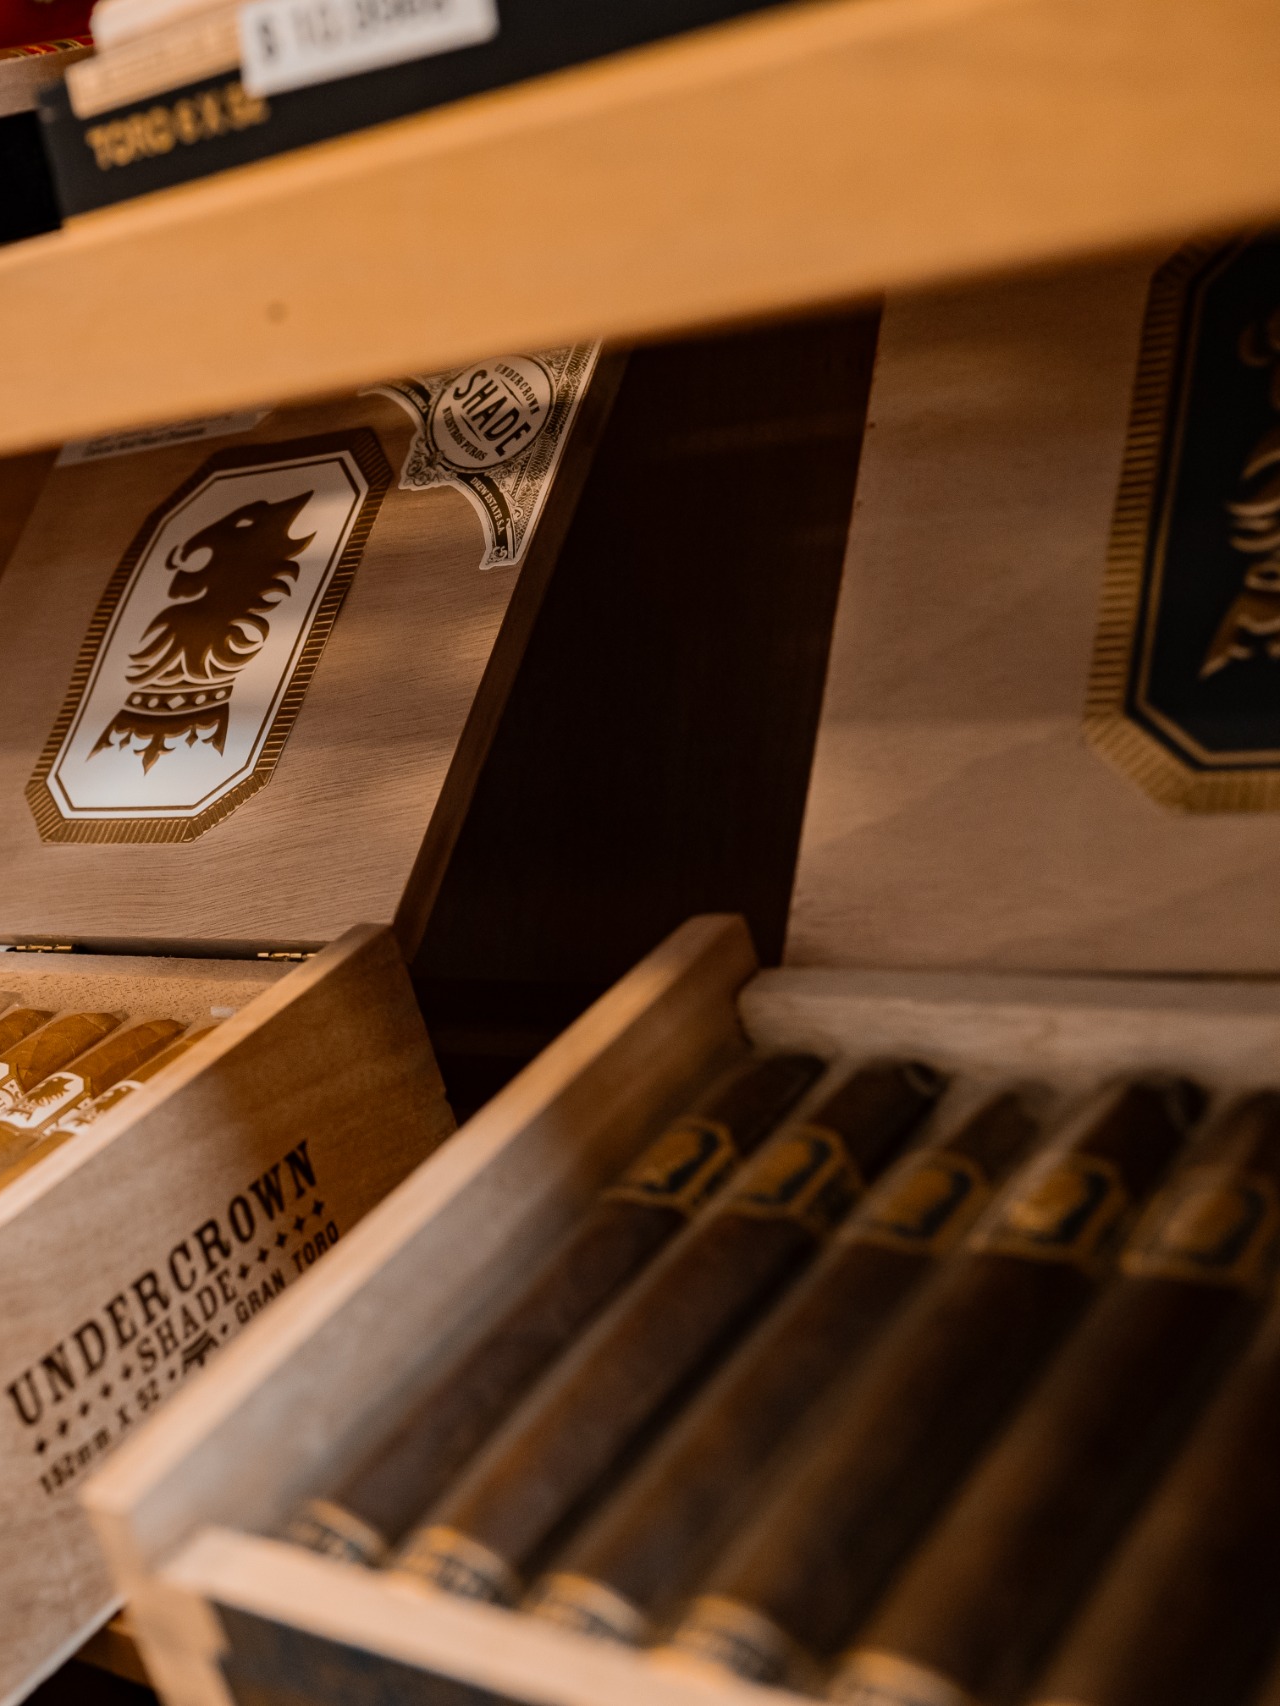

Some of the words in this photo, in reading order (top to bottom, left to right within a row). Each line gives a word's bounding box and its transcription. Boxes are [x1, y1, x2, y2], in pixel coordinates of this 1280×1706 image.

[452, 368, 533, 458] SHADE
[494, 363, 541, 416] UNDERCROWN
[7, 1138, 318, 1428] UNDERCROWN
[133, 1265, 240, 1376] SHADE
[233, 1267, 287, 1326] GRAN
[291, 1219, 340, 1274] TORO
